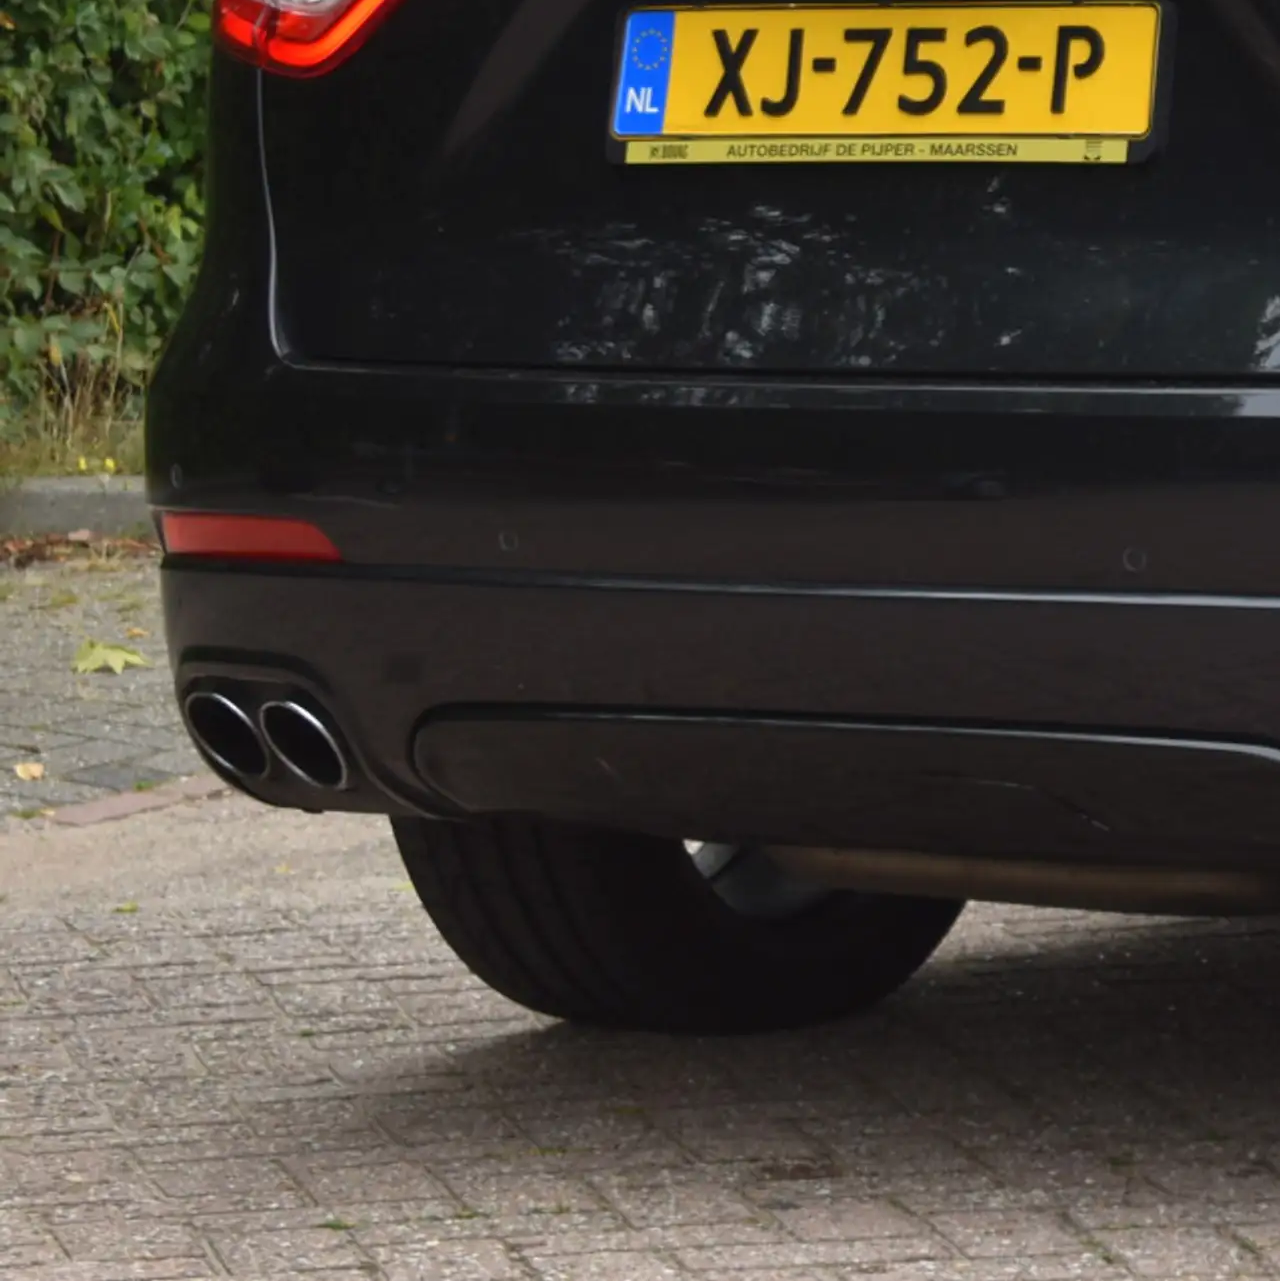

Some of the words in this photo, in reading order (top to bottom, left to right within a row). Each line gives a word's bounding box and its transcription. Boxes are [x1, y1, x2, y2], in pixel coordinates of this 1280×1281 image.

[703, 23, 1106, 118] XJ-752-P
[624, 87, 660, 115] NL
[726, 142, 831, 159] AUTOBEDRIJF
[835, 142, 856, 157] DE
[860, 142, 916, 157] PIJPER
[929, 141, 1019, 157] MAARSSEN
